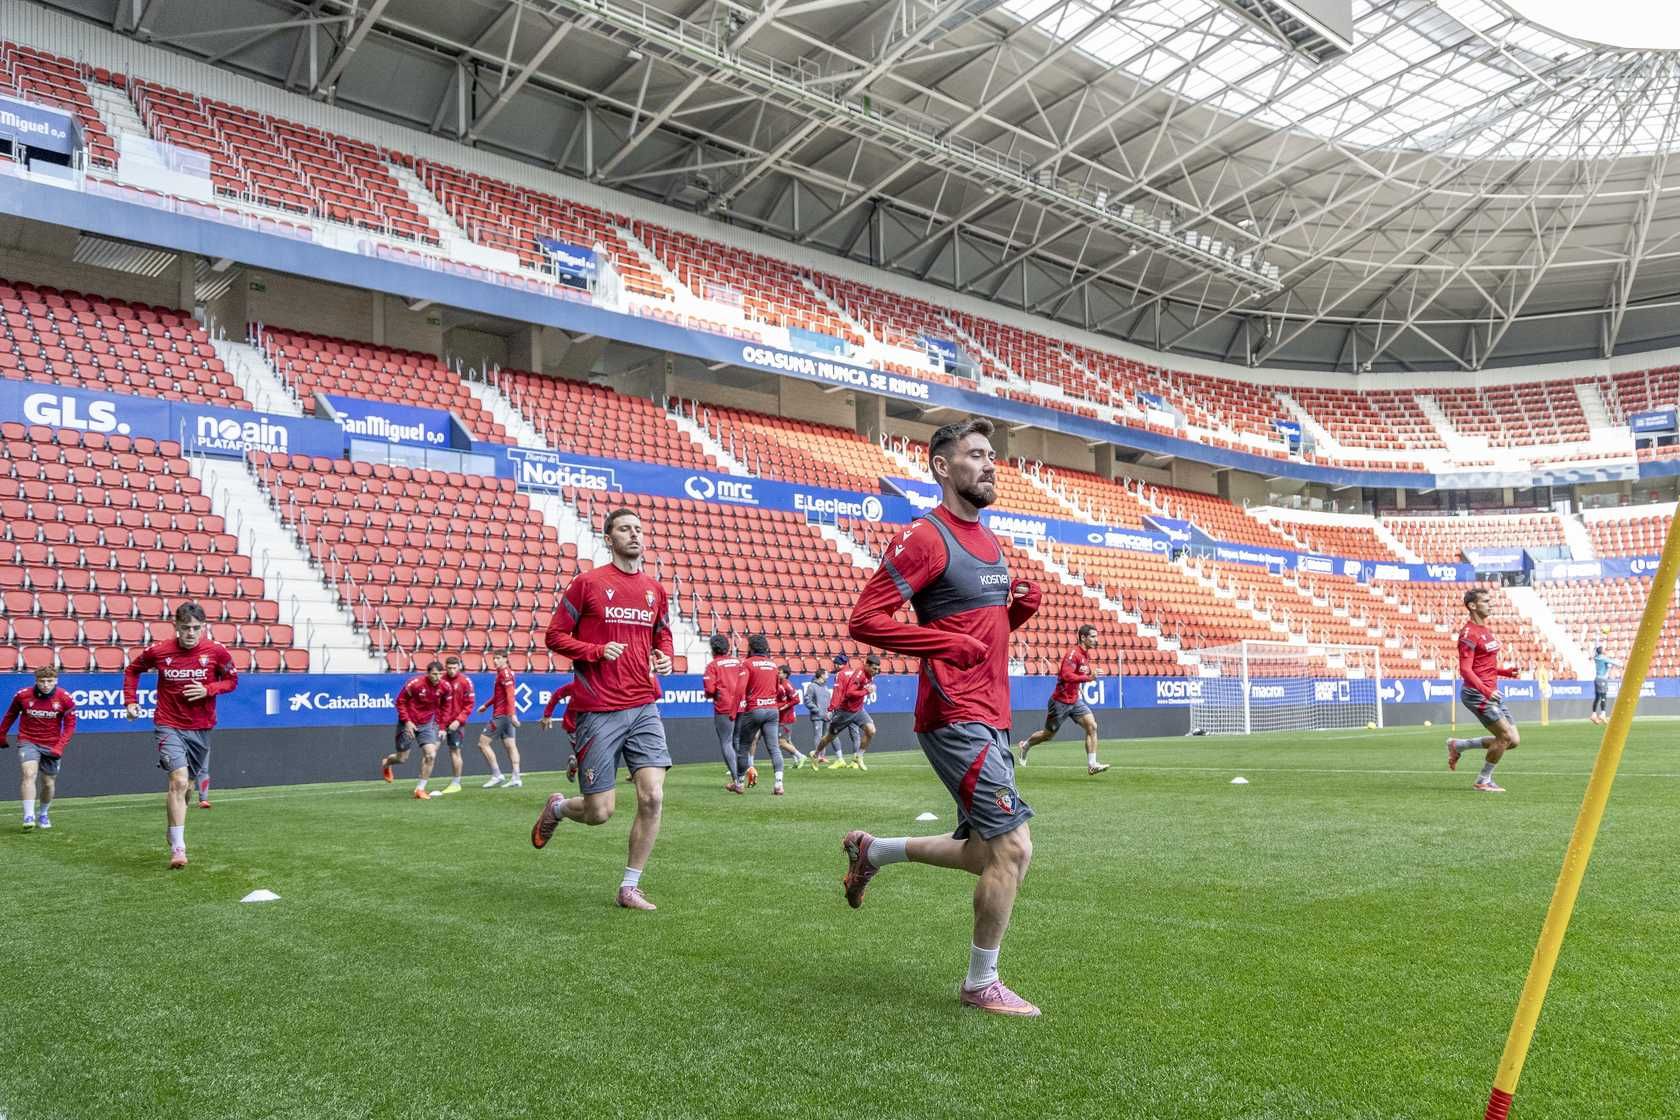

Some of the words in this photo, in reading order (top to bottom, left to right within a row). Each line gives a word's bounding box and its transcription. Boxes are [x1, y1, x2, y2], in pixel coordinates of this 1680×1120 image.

[742, 346, 817, 376] OSASUNA
[818, 361, 868, 387] NUNCA
[870, 373, 887, 391] SE
[889, 377, 929, 399] RINDE
[24, 393, 131, 434] GLS.
[523, 461, 607, 490] Noticias
[718, 480, 753, 499] mrc
[314, 692, 395, 709] CaixaBank
